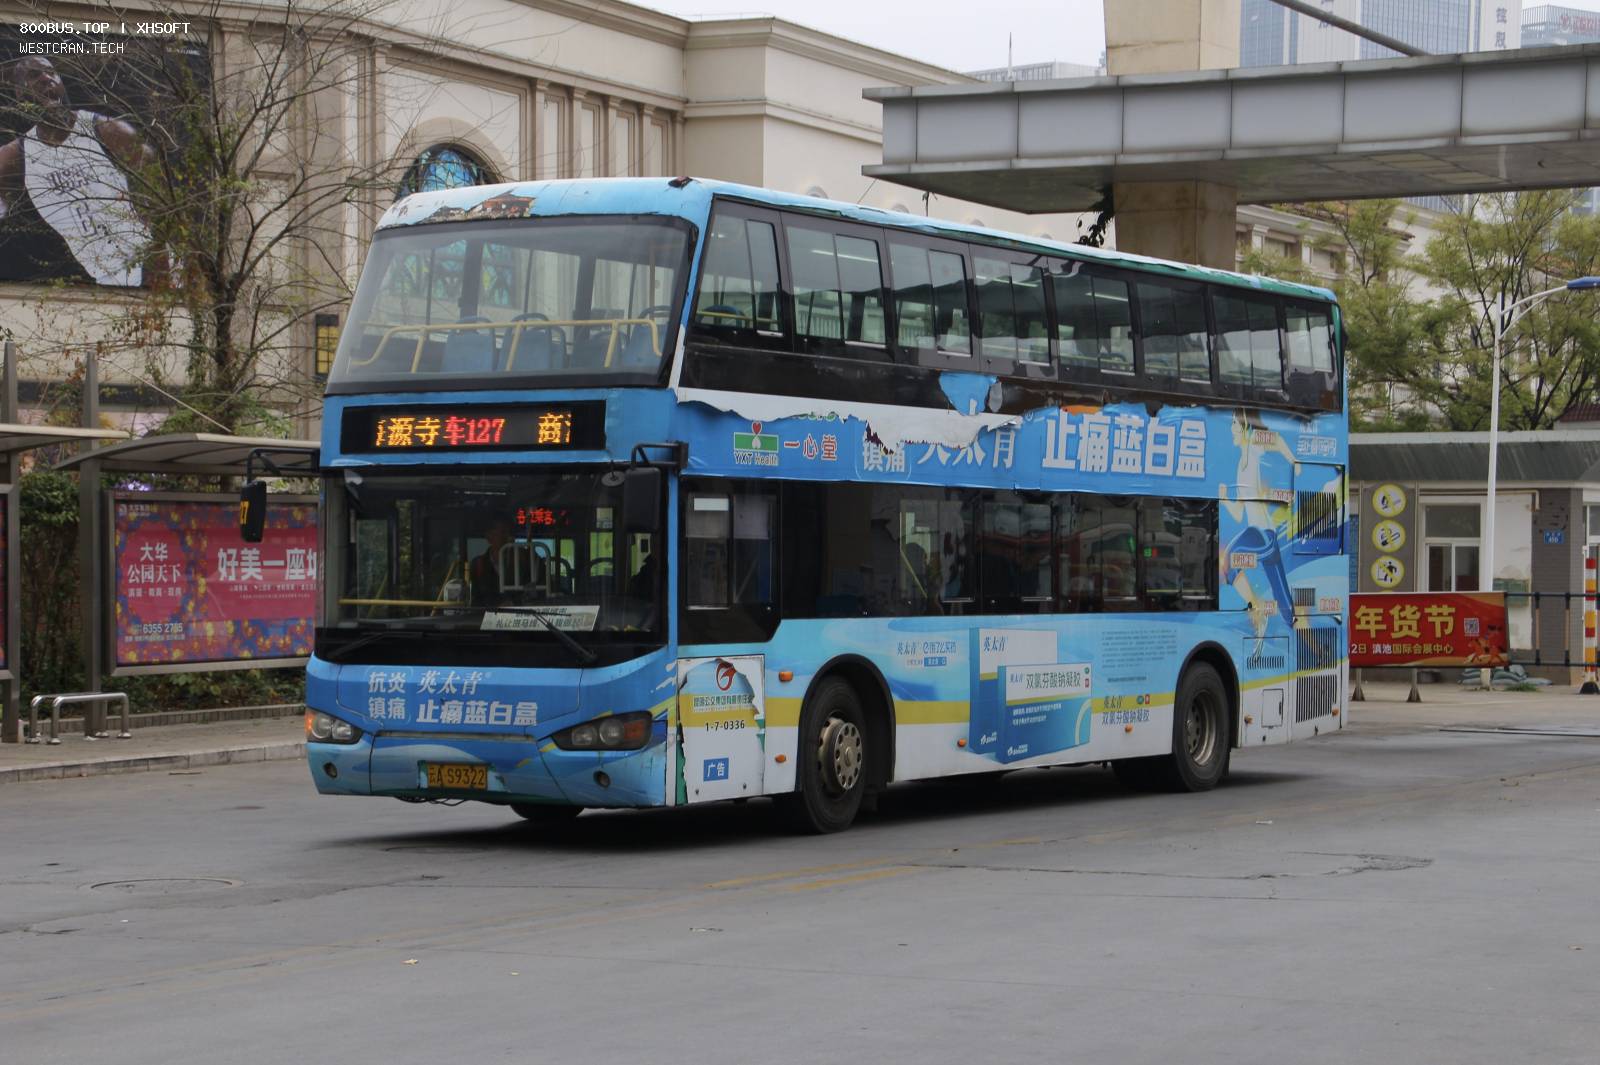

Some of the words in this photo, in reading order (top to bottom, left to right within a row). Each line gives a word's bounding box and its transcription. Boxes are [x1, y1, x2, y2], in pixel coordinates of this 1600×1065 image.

[784, 433, 837, 461] 一心堂
[1042, 411, 1206, 479] 止痛蓝白盒
[140, 542, 168, 561] 大华
[128, 564, 181, 584] 公园天下
[1355, 604, 1456, 639] 年货节
[1372, 643, 1454, 655] 滇池国际会展中心
[368, 671, 406, 694] 抗炎
[417, 670, 484, 695] 英太青
[368, 698, 406, 720] 镇痛
[416, 700, 538, 726] 止痛蓝白盒
[705, 720, 745, 732] 1-7-0336
[447, 767, 485, 786] S9322
[707, 761, 725, 777] 广告
